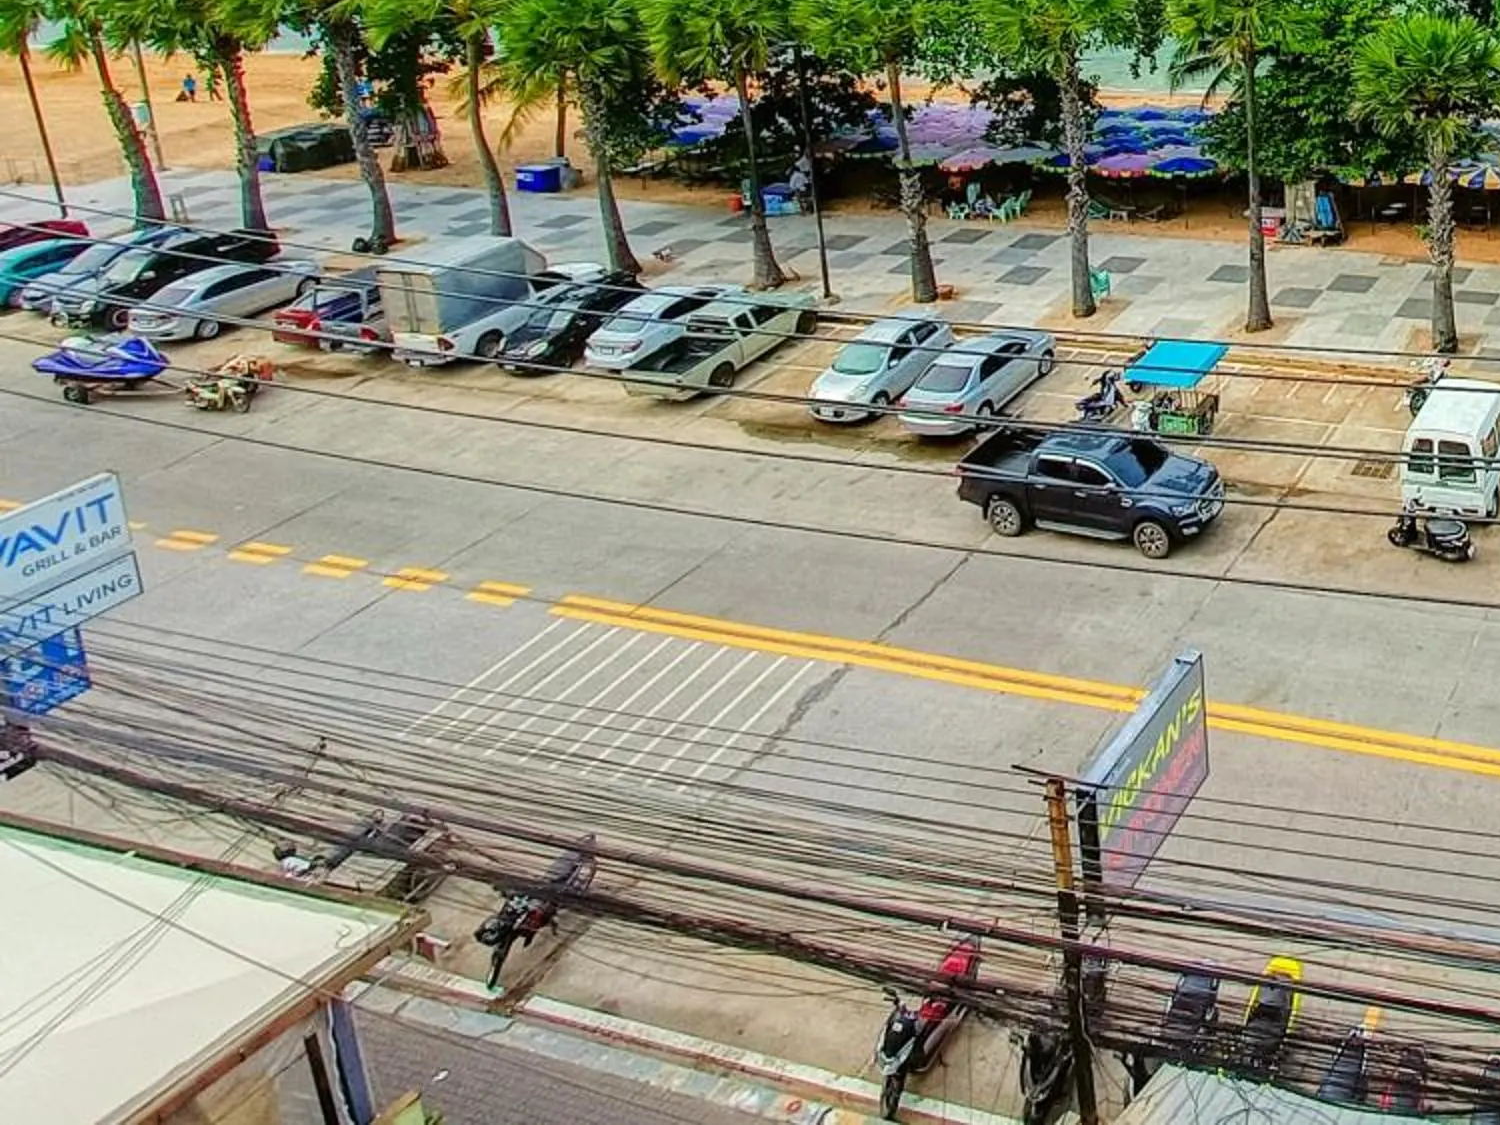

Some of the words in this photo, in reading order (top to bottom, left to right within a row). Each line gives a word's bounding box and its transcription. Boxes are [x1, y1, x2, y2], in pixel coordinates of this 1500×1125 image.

[22, 551, 69, 577] GRILL
[74, 542, 87, 556] &
[89, 525, 122, 549] BAR
[63, 573, 133, 615] LIVING
